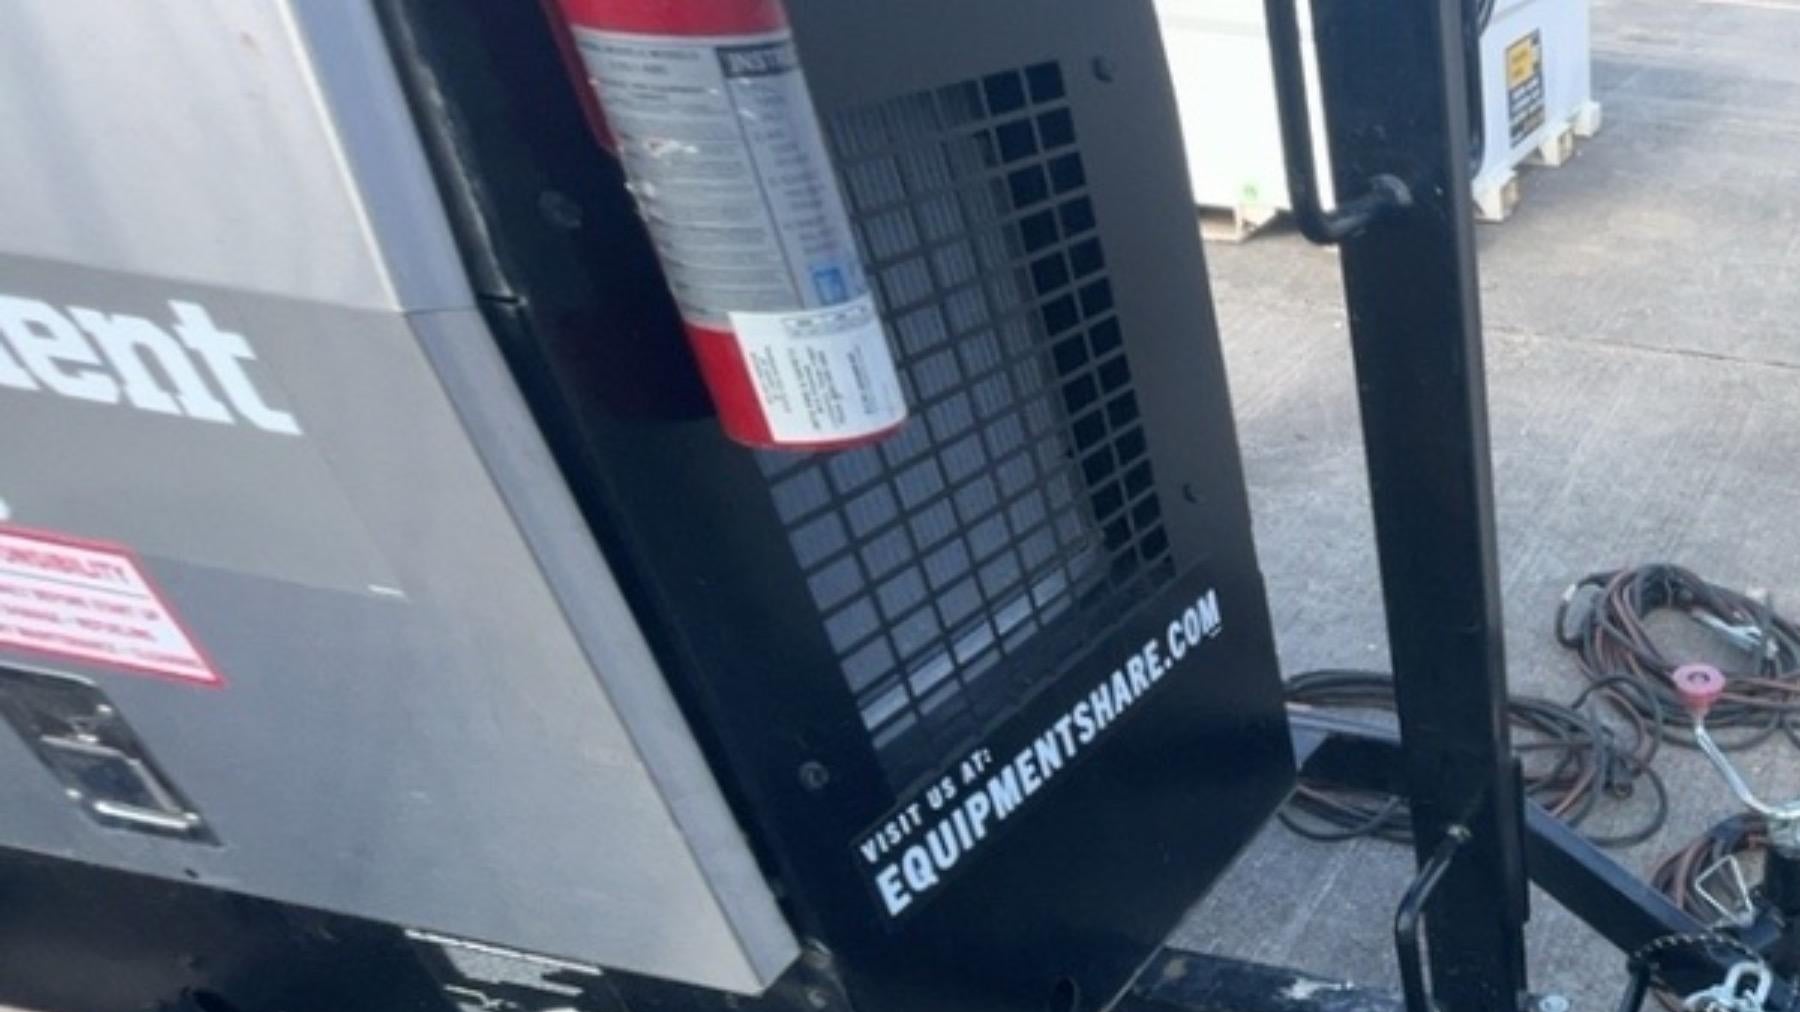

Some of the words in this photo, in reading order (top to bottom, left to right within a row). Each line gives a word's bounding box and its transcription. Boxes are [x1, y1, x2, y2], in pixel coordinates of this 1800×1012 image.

[860, 803, 922, 863] VISIT
[926, 776, 957, 810] US
[875, 588, 1222, 916] EQUIPMENTSHARE.COM
